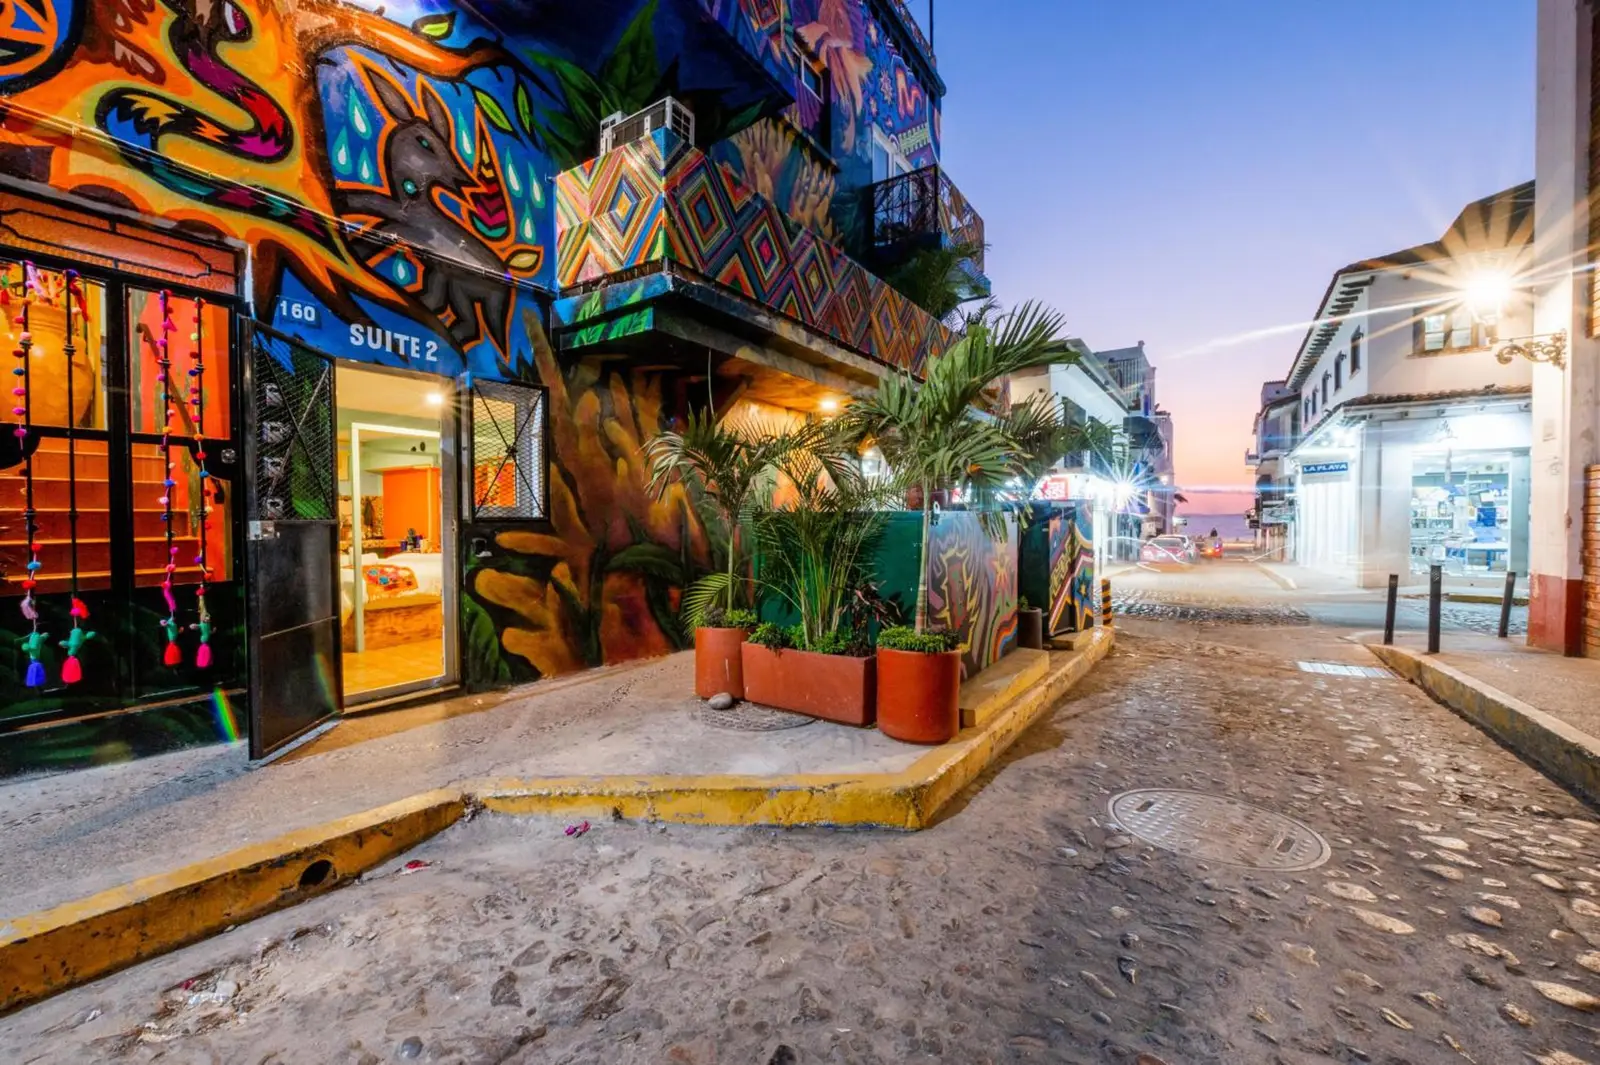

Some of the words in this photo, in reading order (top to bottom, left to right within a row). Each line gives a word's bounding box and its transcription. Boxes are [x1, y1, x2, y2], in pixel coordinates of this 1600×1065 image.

[280, 300, 316, 322] 160
[350, 323, 420, 358] SUITE
[425, 340, 438, 362] 2
[1317, 463, 1347, 471] PLAYA
